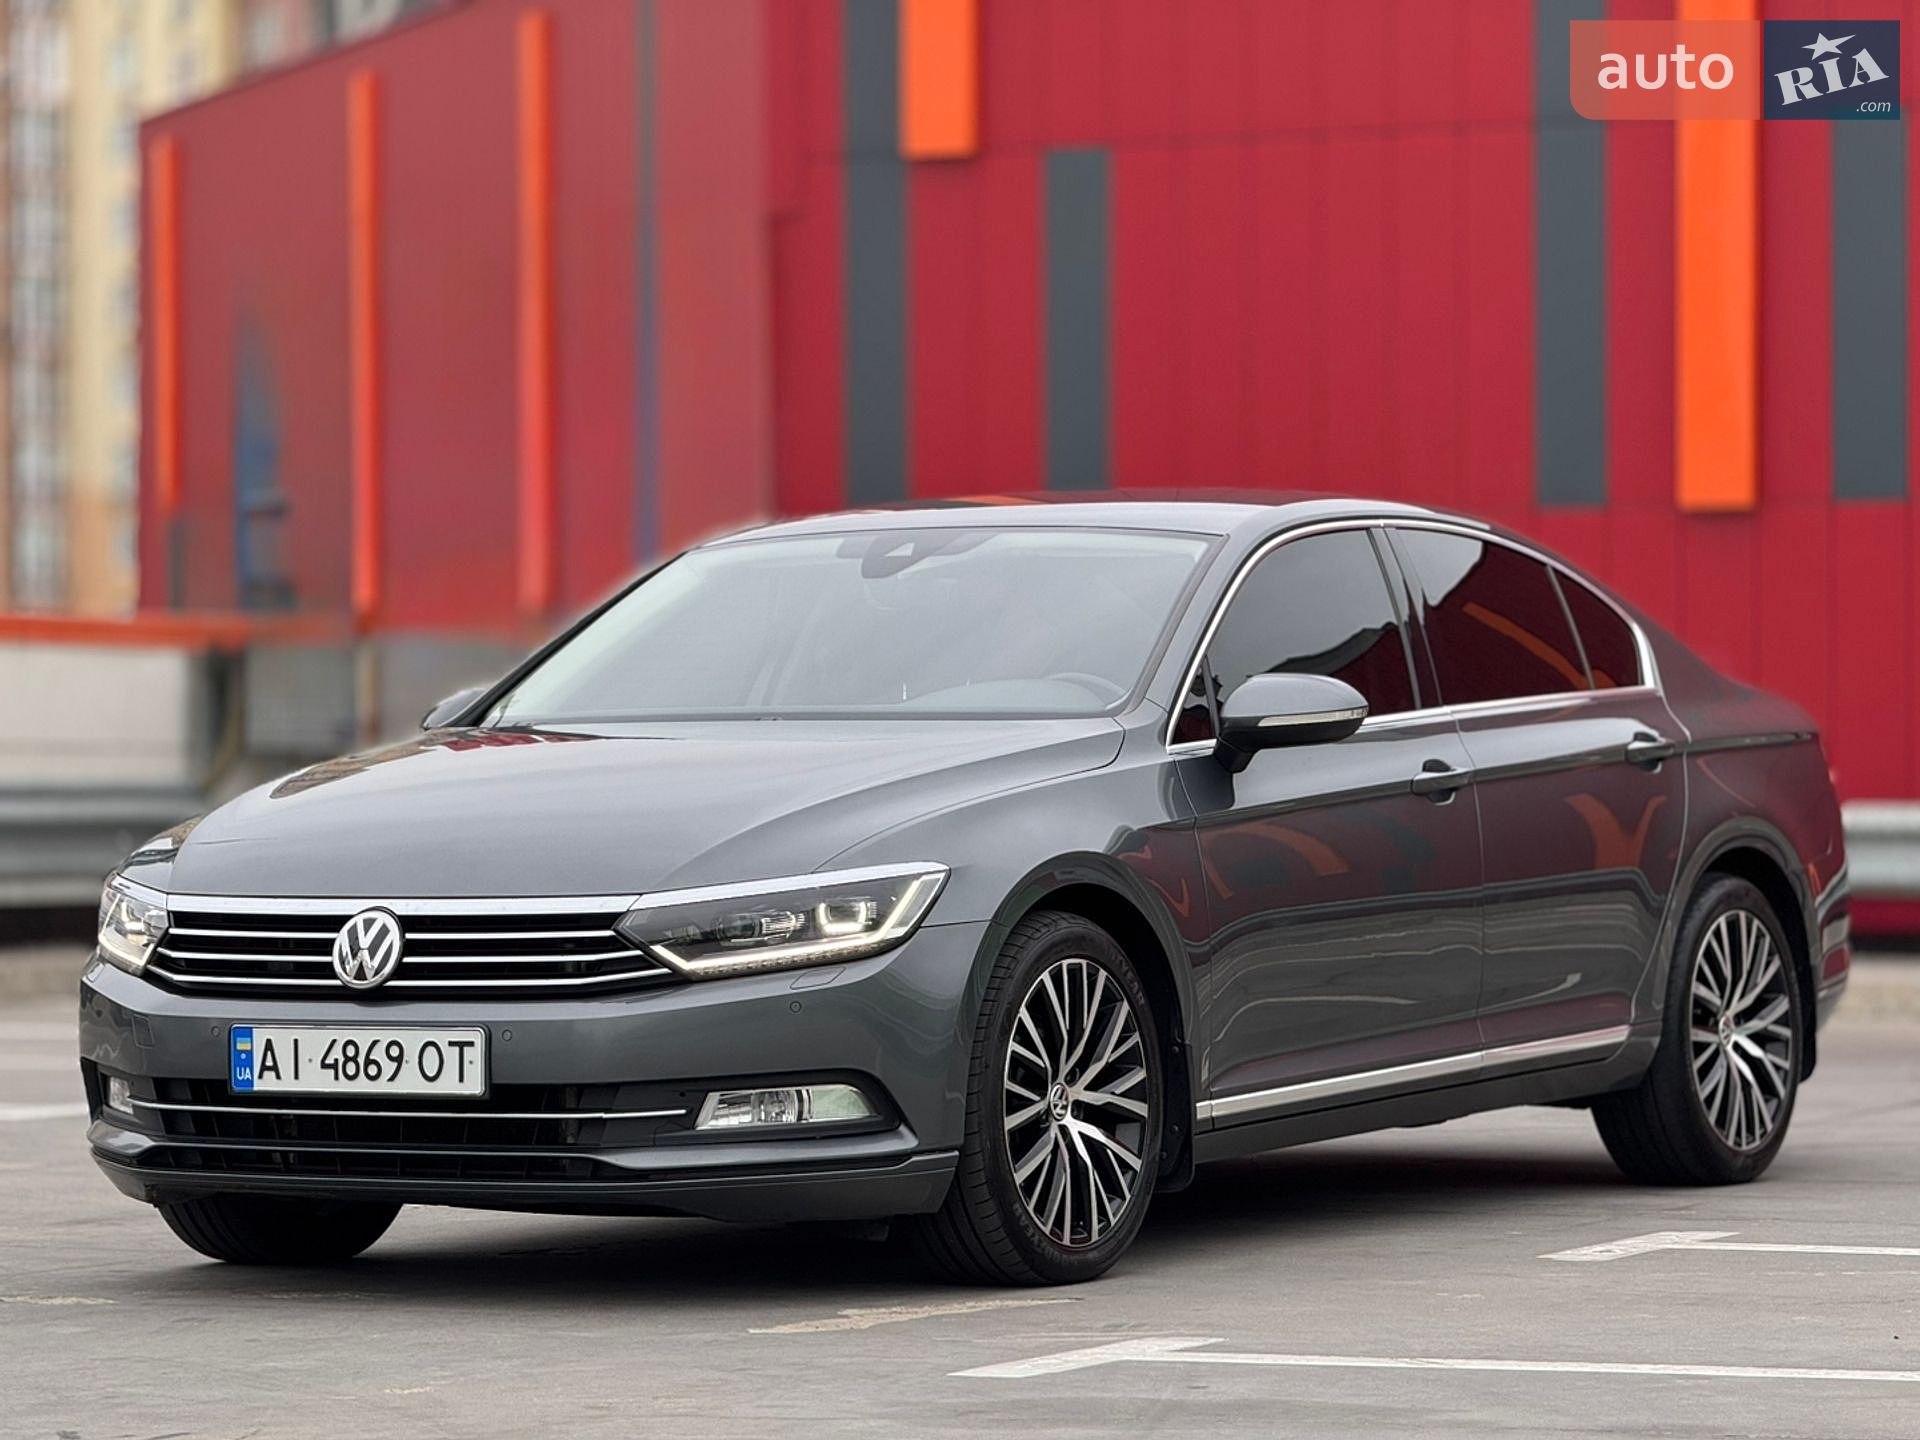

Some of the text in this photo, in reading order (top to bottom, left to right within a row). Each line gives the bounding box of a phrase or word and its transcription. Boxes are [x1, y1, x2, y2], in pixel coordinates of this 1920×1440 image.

[236, 1067, 252, 1081] UA
[257, 1038, 475, 1083] AI 4869 OT
